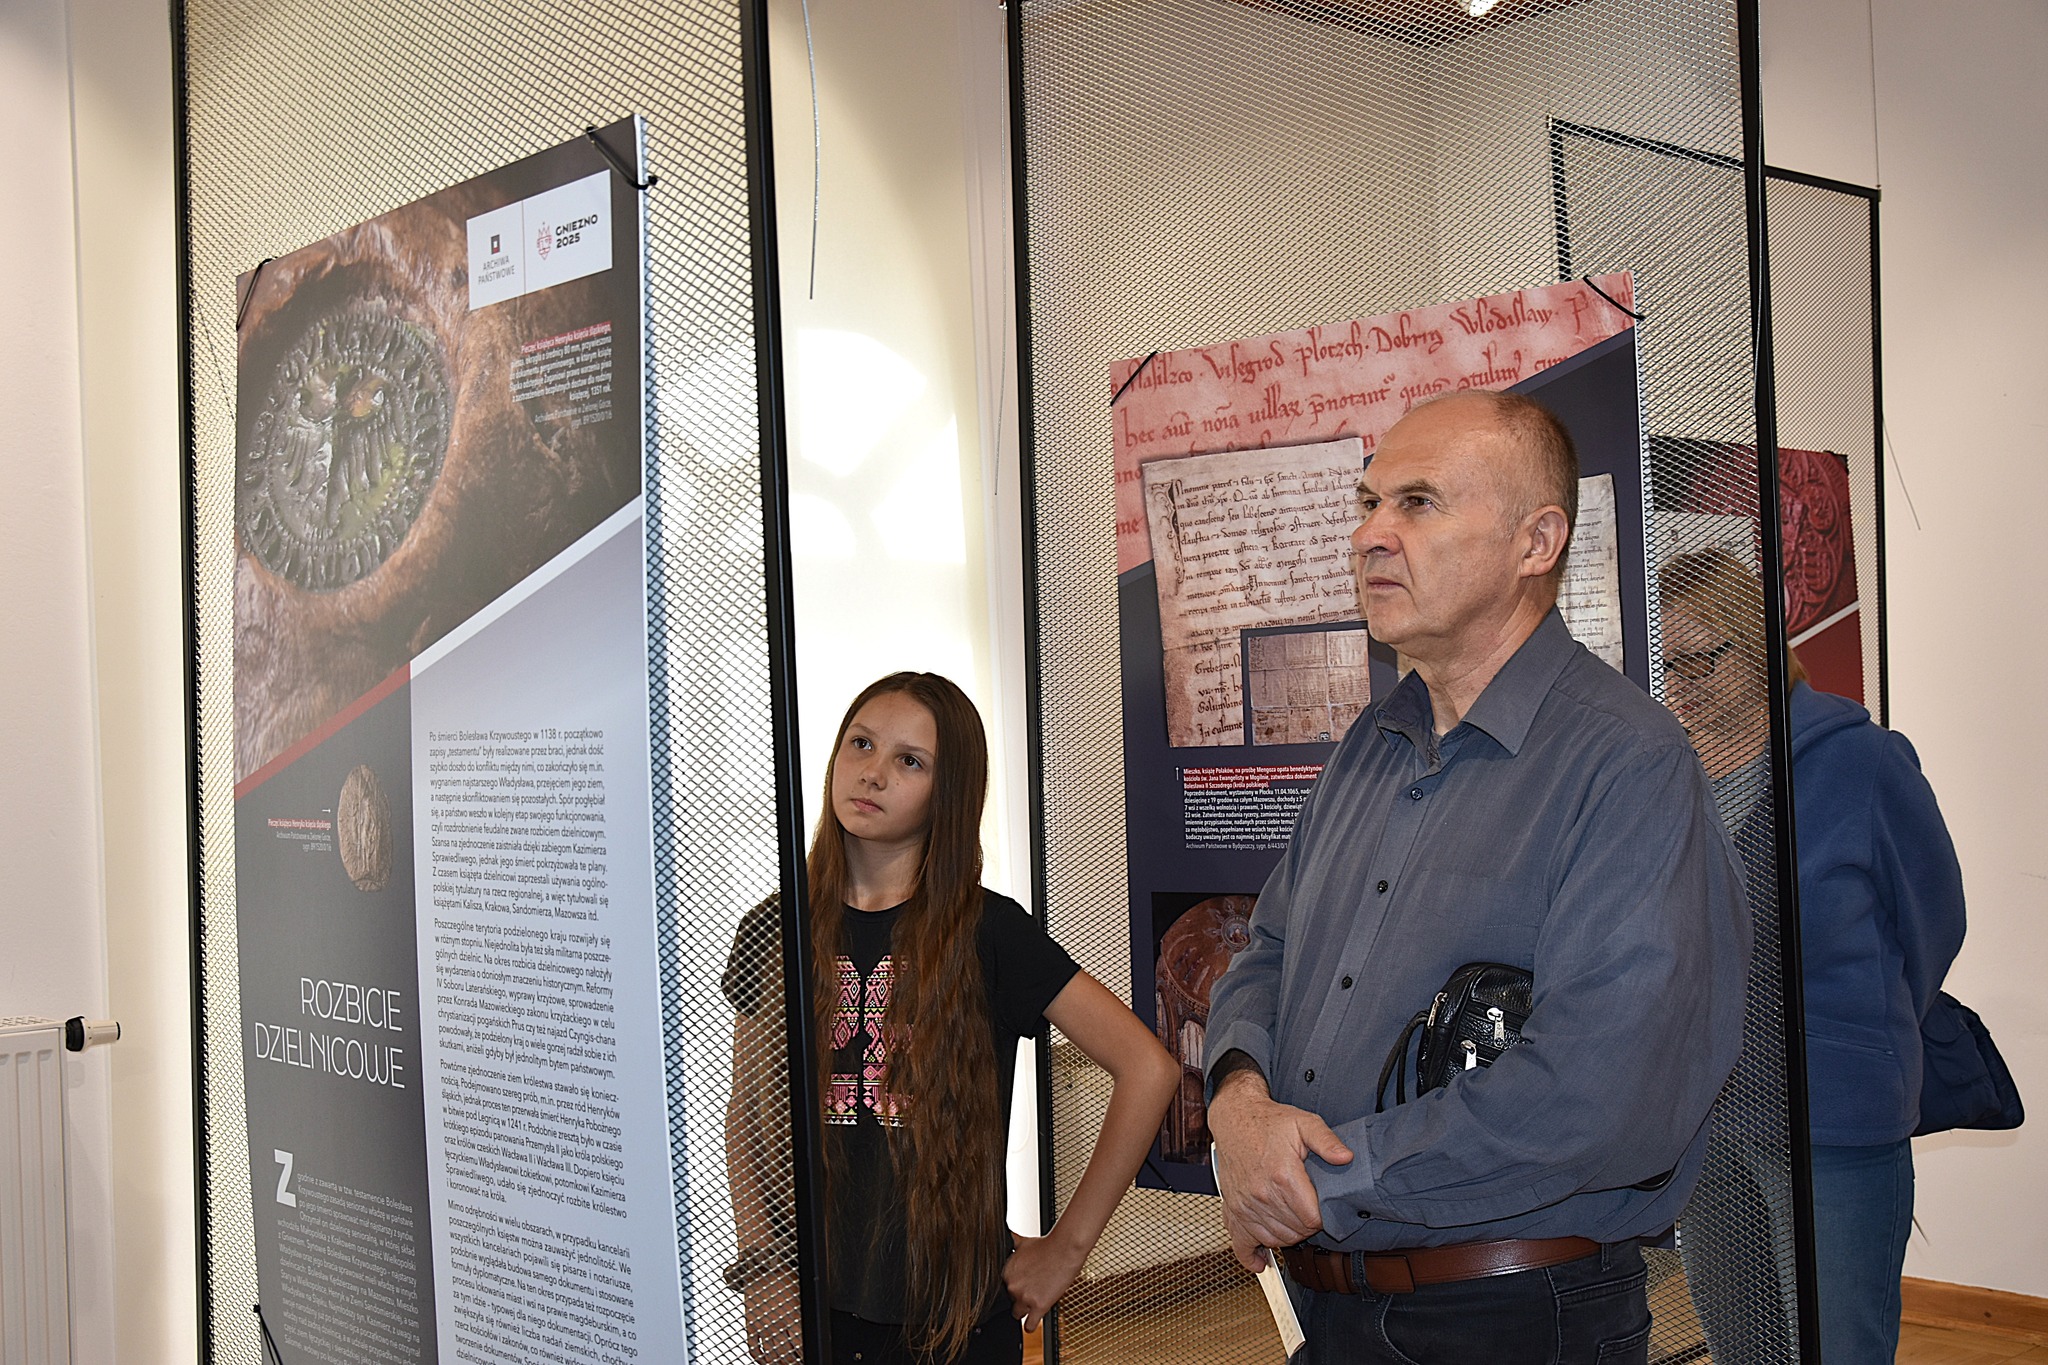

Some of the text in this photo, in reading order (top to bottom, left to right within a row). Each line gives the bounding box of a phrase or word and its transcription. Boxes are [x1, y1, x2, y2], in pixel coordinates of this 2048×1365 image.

[555, 214, 598, 236] GNIEZNO
[556, 232, 580, 248] 2025
[478, 265, 515, 284] PAŃSTWOWE
[482, 256, 510, 270] ARCHIWA
[429, 731, 437, 741] Po
[437, 731, 458, 741] śmierci
[459, 730, 488, 741] Bolesława
[540, 728, 557, 740] 1138
[558, 731, 563, 740] r.
[430, 777, 462, 790] wygnaniem
[571, 777, 587, 792] jego
[587, 778, 605, 790] ziem,
[478, 854, 499, 867] jednak
[499, 855, 514, 869] jego
[514, 856, 535, 868] śmierć
[579, 861, 587, 871] te
[587, 860, 608, 875] plany.
[432, 866, 437, 877] Z
[437, 869, 459, 878] czasem
[459, 868, 482, 882] książęta
[551, 874, 581, 889] używania
[581, 876, 608, 891] ogólno-
[462, 899, 484, 912] Kalisza,
[484, 901, 512, 914] Krakowa,
[554, 907, 587, 920] Mazowsza
[588, 910, 599, 921] itd.
[475, 924, 502, 936] terytoria
[550, 929, 567, 944] kraju
[568, 933, 599, 948] rozwijały
[600, 935, 611, 949] się
[435, 948, 458, 962] gólnych
[458, 950, 483, 964] dzielnic.
[483, 953, 493, 965] Na
[493, 954, 511, 967] okres
[512, 957, 536, 970] rozbicia
[585, 966, 612, 983] nałożyły
[301, 977, 402, 1031] ROZBICIE
[436, 977, 443, 988] IV
[443, 978, 464, 992] Soboru
[508, 991, 536, 1004] wyprawy
[536, 991, 568, 1007] krzyżowe,
[437, 995, 453, 1005] przez
[453, 995, 478, 1008] Konrada
[526, 1006, 549, 1019] zakonu
[592, 1019, 599, 1027] w
[600, 1017, 615, 1029] celu
[255, 1022, 405, 1088] DZIELNICOWE
[440, 1058, 467, 1073] Powtórne
[507, 1072, 522, 1084] ziem
[523, 1074, 553, 1090] królestwa
[554, 1082, 579, 1095] stawało
[580, 1086, 590, 1100] się
[591, 1087, 619, 1102] koniecz-
[274, 1148, 296, 1208] Z
[496, 1177, 516, 1190] udało
[516, 1182, 526, 1196] się
[566, 1195, 591, 1209] rozbite
[592, 1199, 627, 1218] królestwo
[496, 1227, 520, 1243] księstw
[521, 1237, 543, 1250] można
[544, 1243, 576, 1261] zauważyć
[618, 1262, 632, 1275] We
[523, 1252, 549, 1267] pojawili
[550, 1259, 561, 1273] się
[562, 1263, 587, 1278] pisarze
[588, 1268, 592, 1280] i
